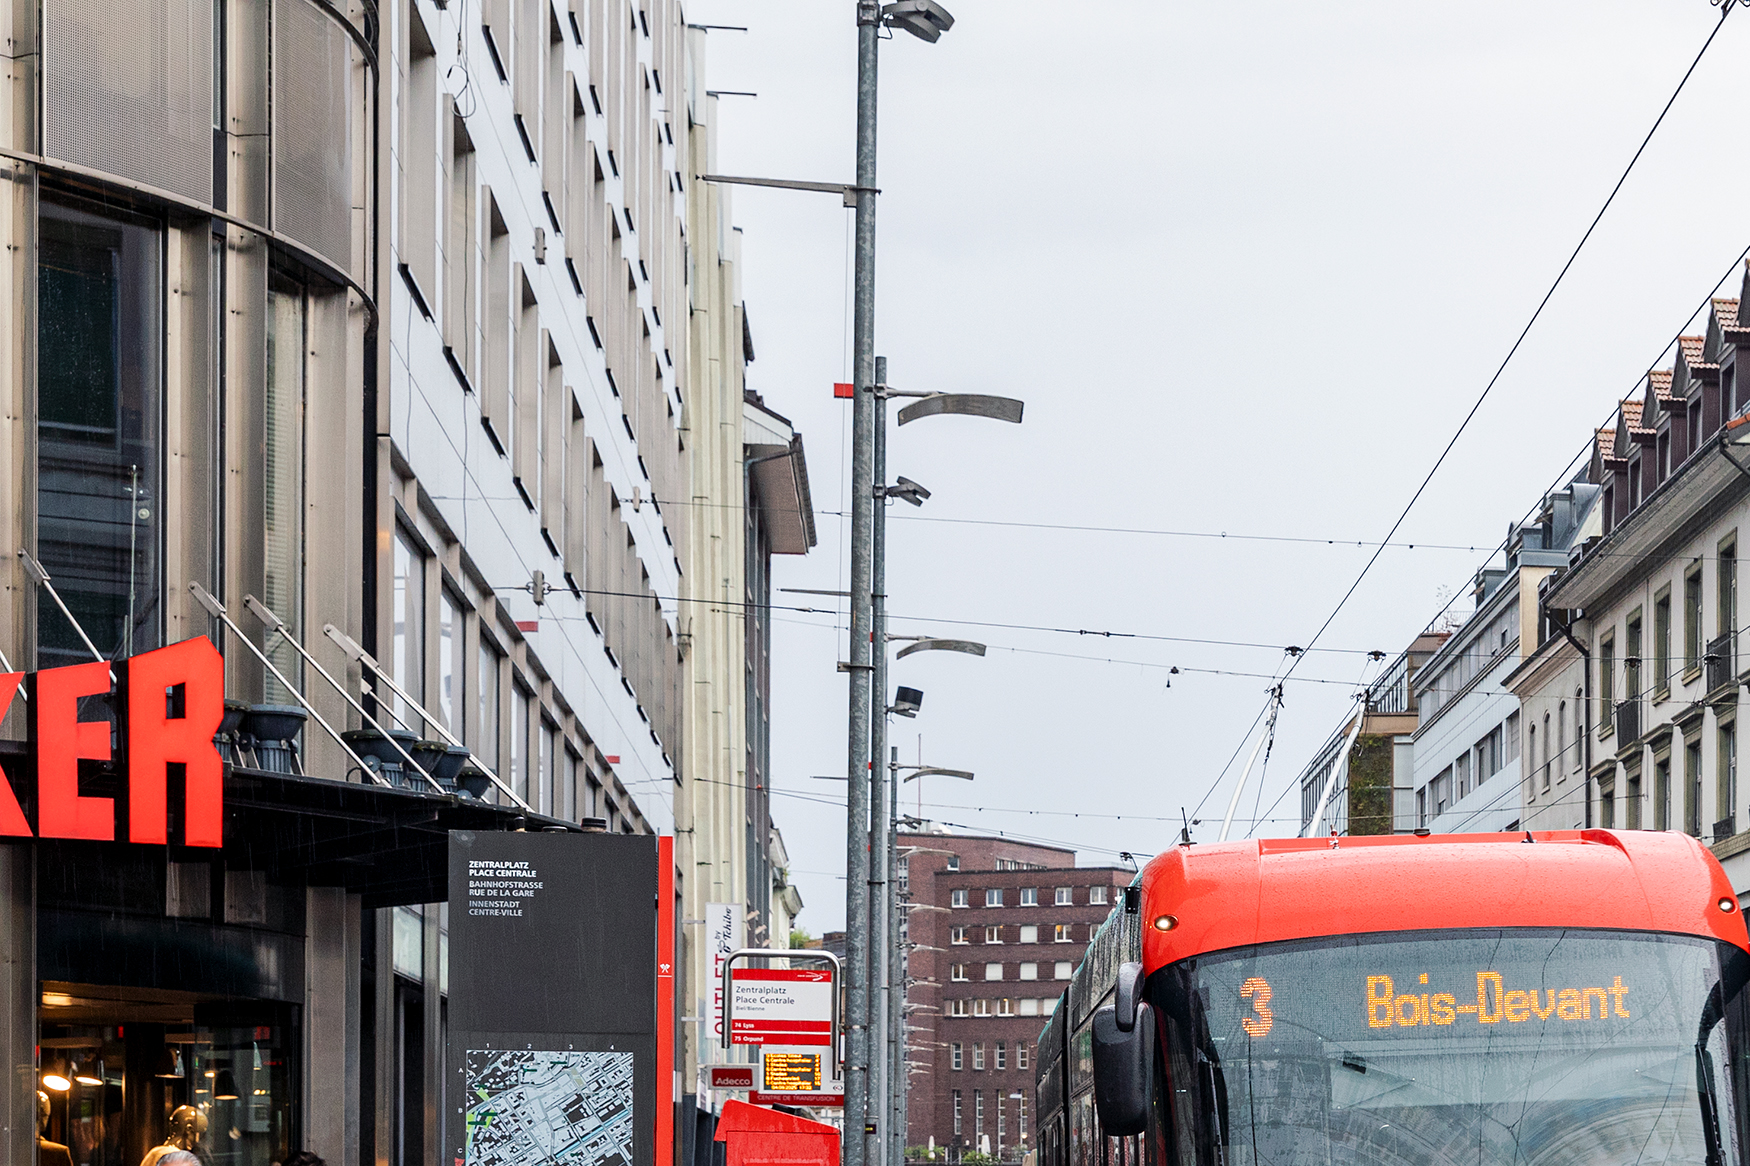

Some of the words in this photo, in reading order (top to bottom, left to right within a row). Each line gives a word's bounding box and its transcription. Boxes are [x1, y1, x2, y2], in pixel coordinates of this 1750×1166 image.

[469, 861, 529, 869] ZENTRALPLATZ
[469, 881, 543, 889] BAHNHOFSTRASSE
[736, 986, 787, 994] Zentralplatz
[736, 996, 757, 1004] Place
[1240, 977, 1273, 1037] 3
[1367, 971, 1630, 1028] Bois-Devant
[715, 1077, 751, 1085] Adecco
